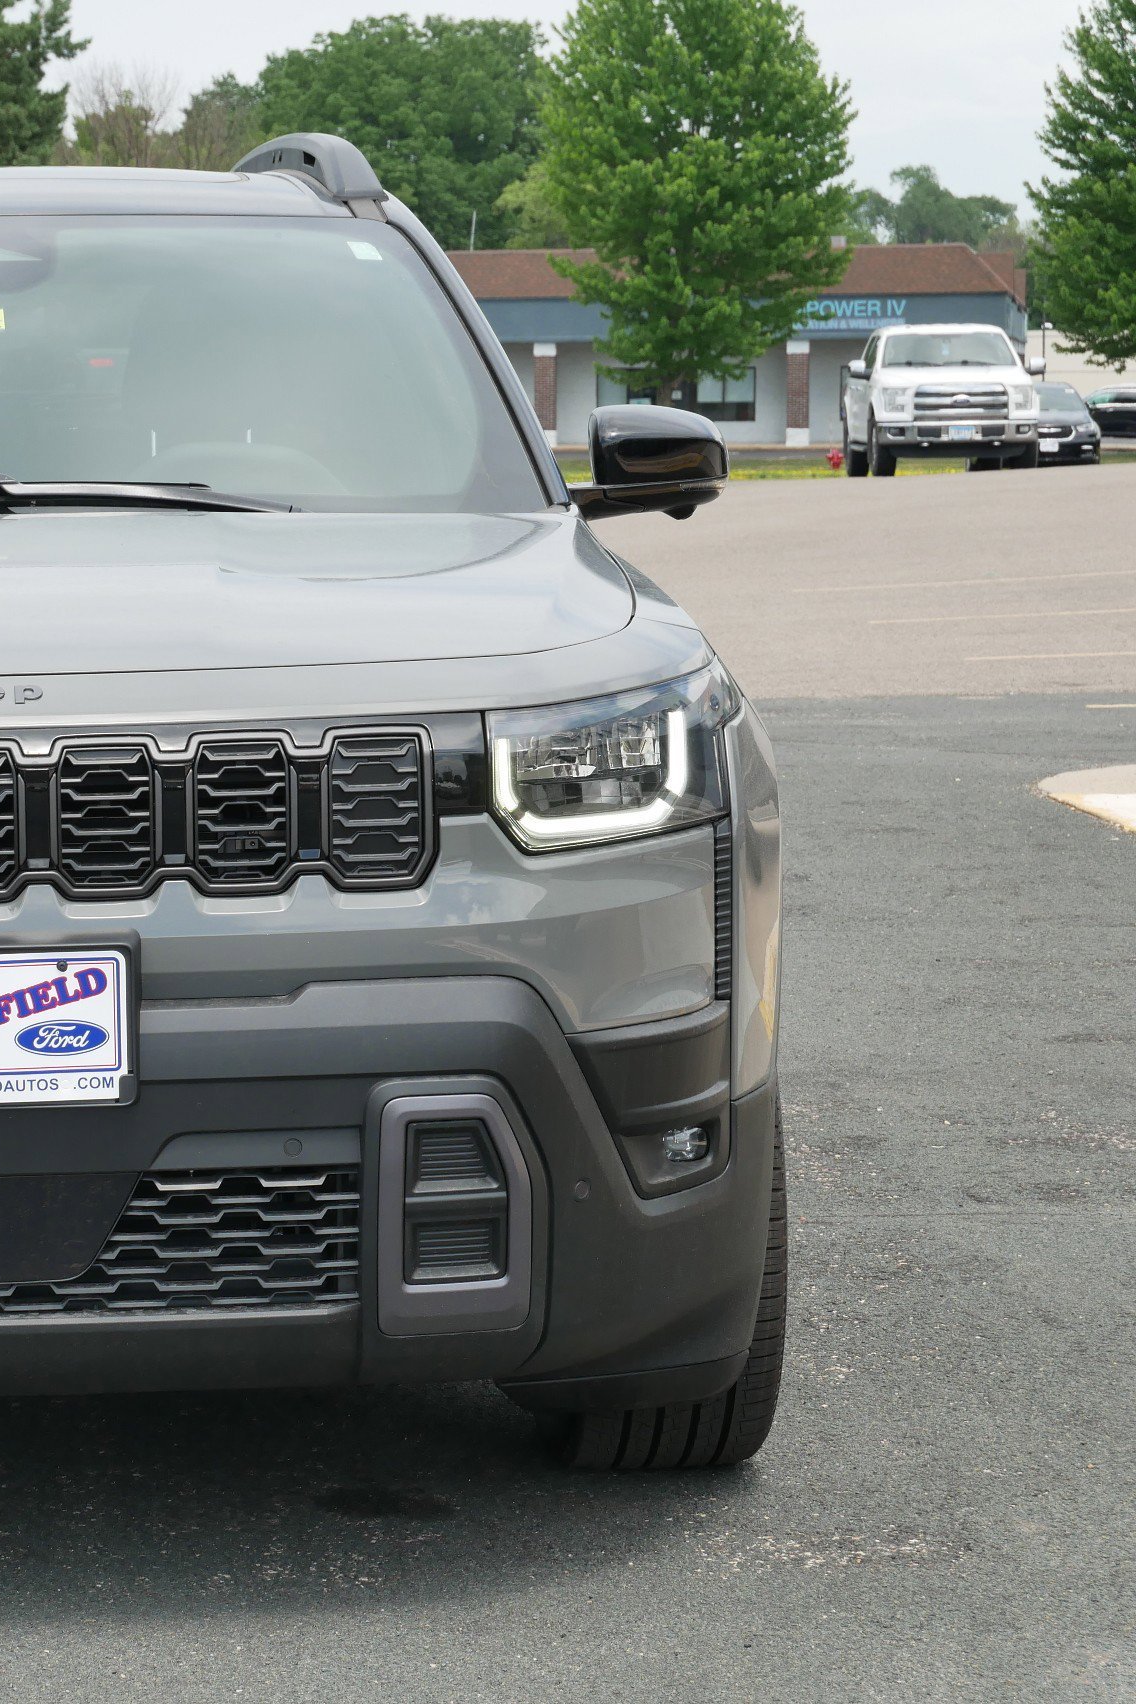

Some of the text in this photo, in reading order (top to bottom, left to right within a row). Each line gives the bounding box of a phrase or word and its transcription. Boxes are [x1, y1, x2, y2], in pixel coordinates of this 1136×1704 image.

[796, 299, 906, 318] POWER IV
[32, 1024, 91, 1049] Ford
[73, 1076, 114, 1090] .COM
